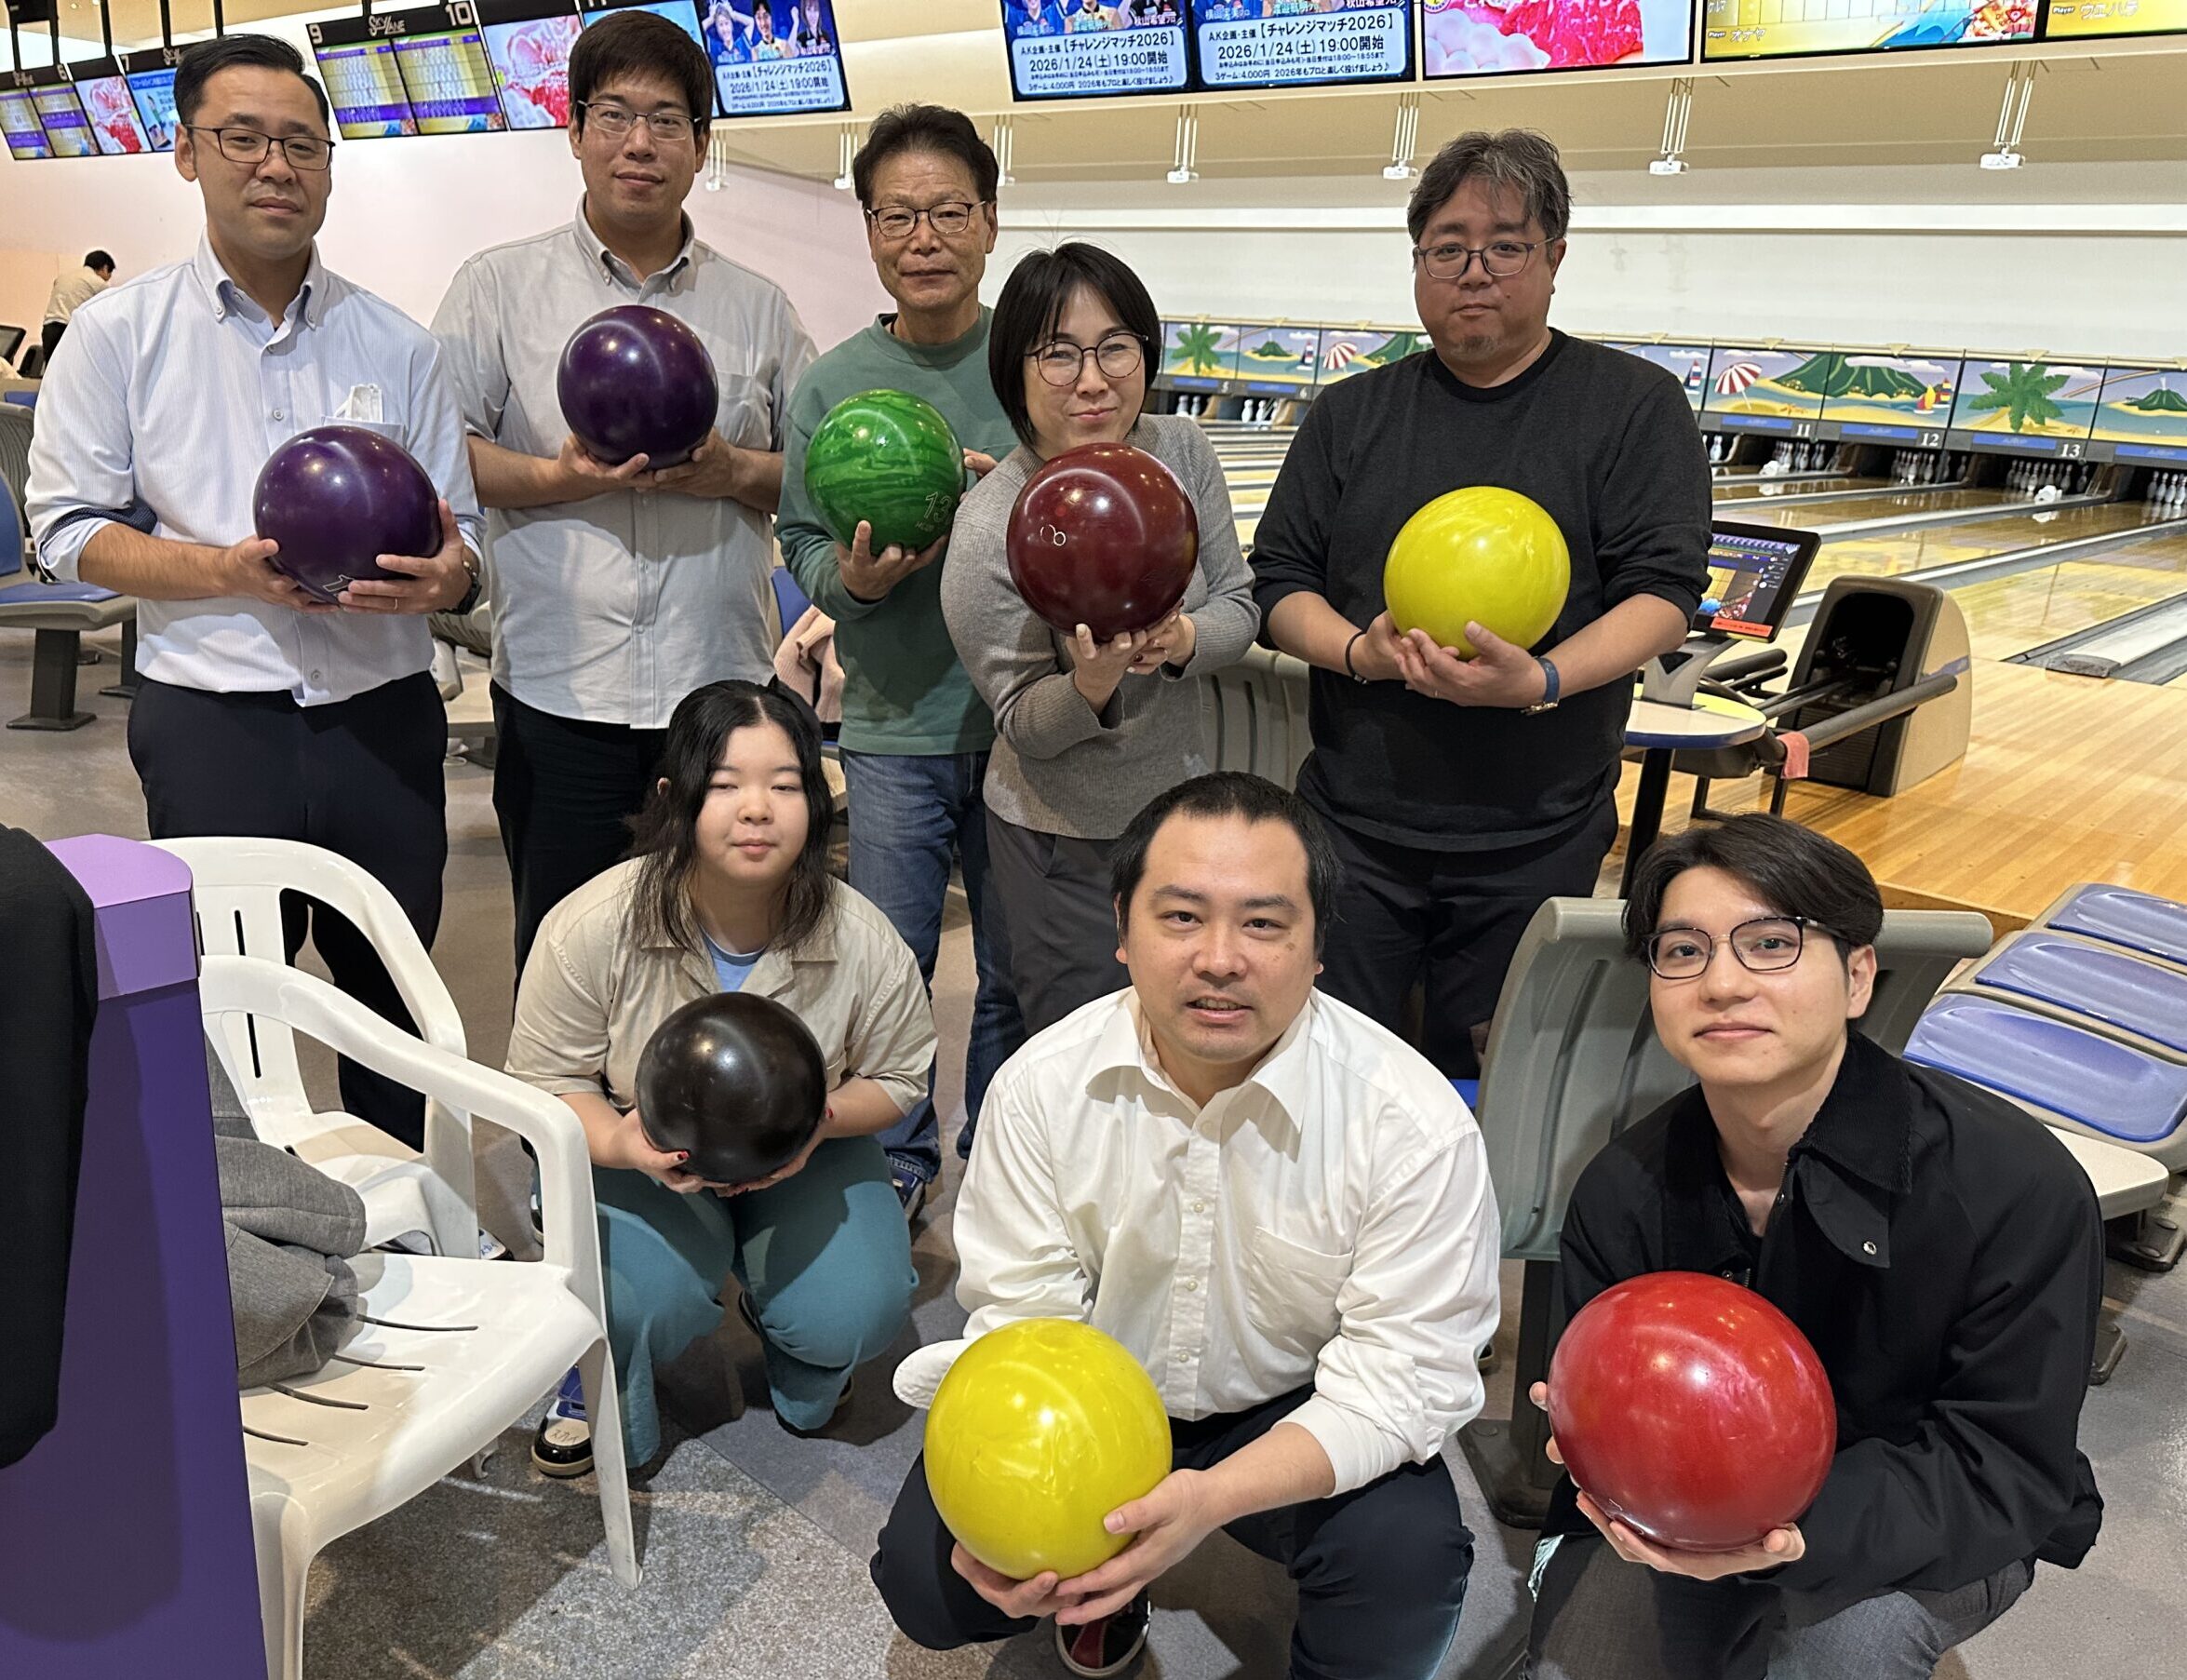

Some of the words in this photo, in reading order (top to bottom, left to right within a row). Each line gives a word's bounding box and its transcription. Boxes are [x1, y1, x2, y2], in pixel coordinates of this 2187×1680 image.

[445, 2, 473, 26] 10
[309, 24, 323, 45] 9
[57, 63, 68, 81] 6
[121, 55, 130, 72] 7
[1795, 423, 1810, 437] 11
[1920, 432, 1939, 446] 12
[2060, 443, 2081, 458] 13
[924, 491, 953, 523] 13
